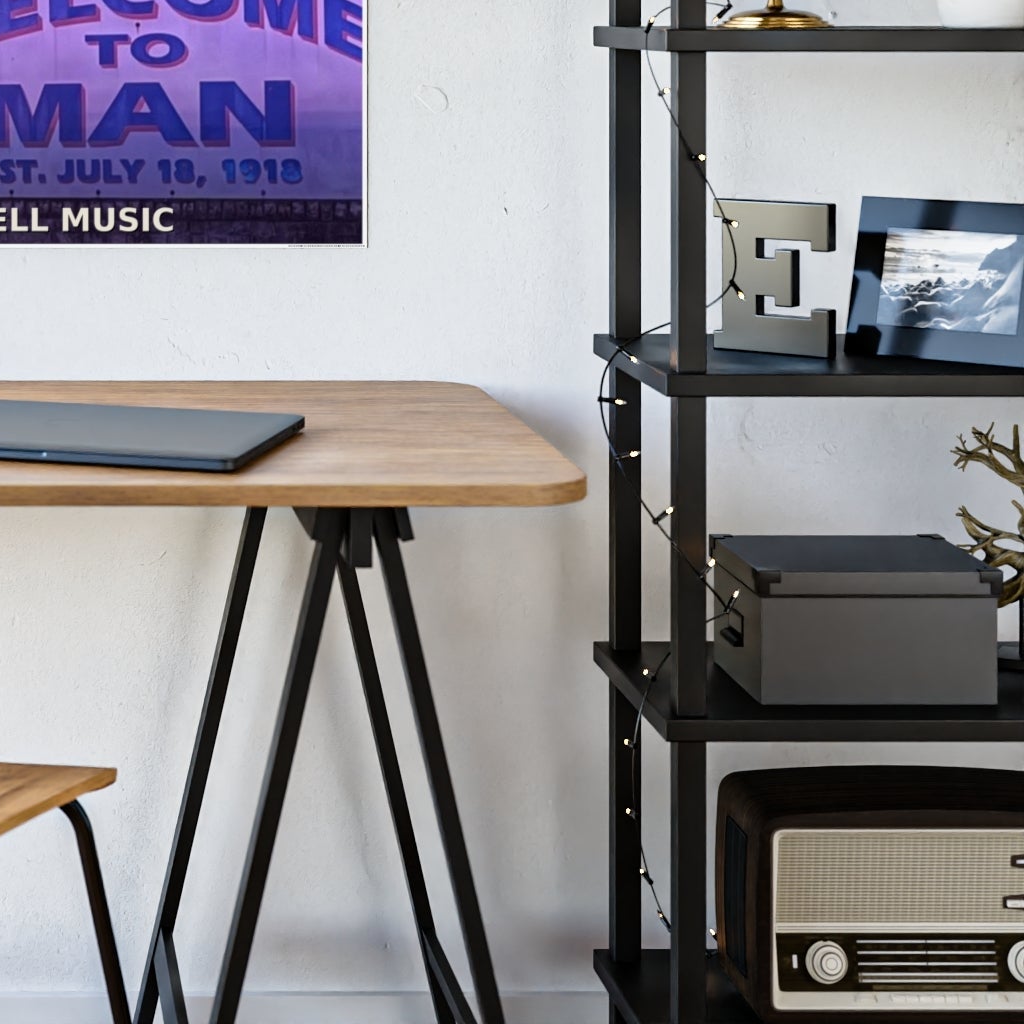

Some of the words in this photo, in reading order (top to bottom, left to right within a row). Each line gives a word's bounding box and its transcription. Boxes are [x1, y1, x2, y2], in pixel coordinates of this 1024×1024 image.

[85, 33, 189, 68] TO
[56, 158, 146, 185] JULY
[157, 158, 208, 189] 18,
[220, 158, 303, 185] 1918
[61, 206, 175, 233] MUSIC
